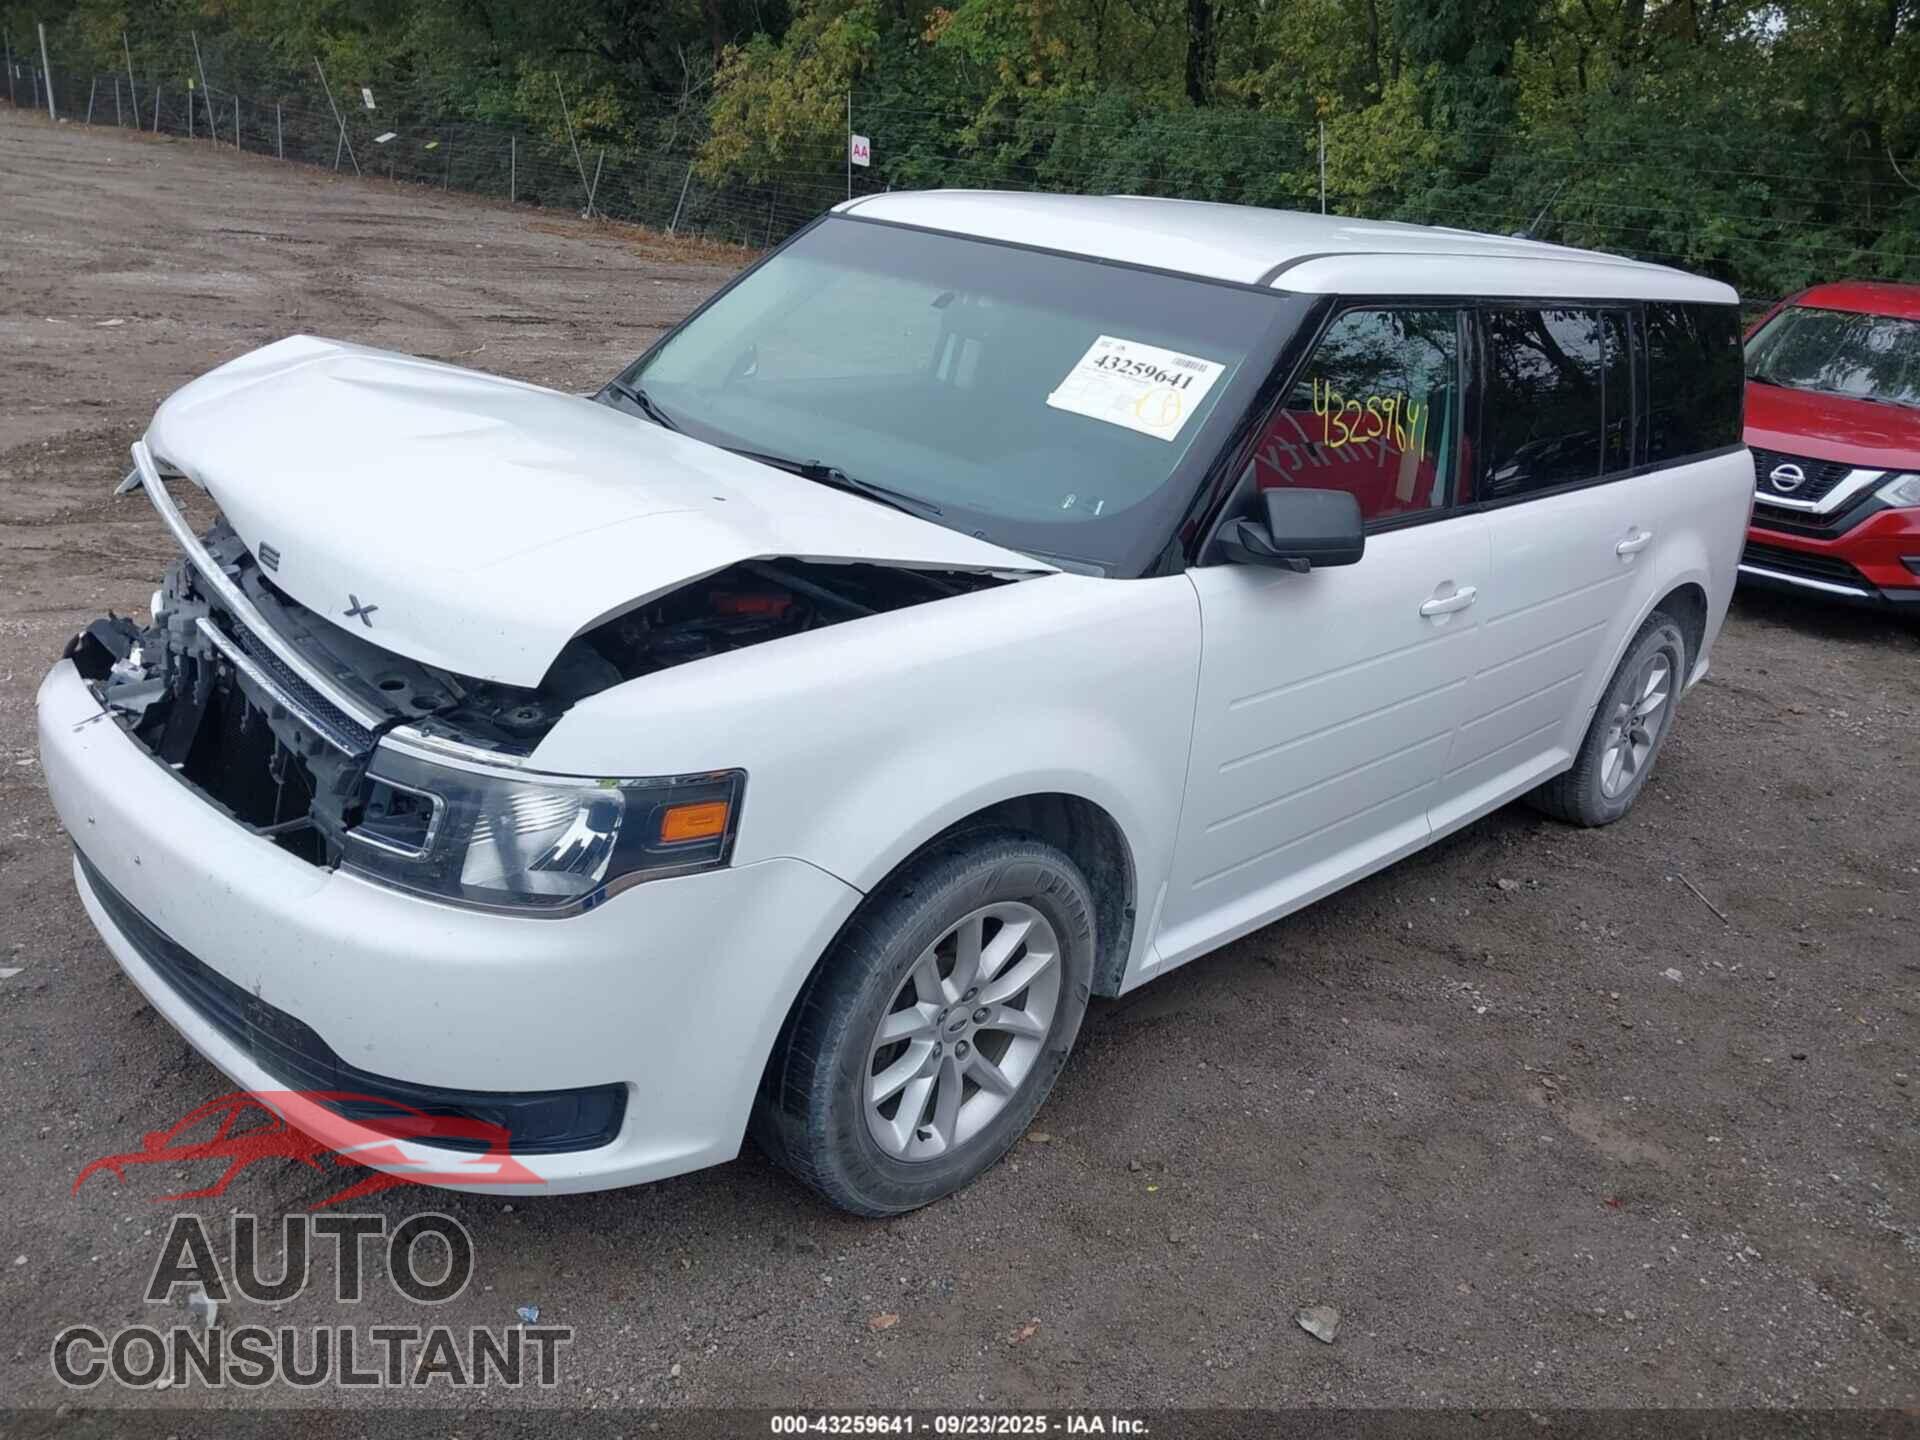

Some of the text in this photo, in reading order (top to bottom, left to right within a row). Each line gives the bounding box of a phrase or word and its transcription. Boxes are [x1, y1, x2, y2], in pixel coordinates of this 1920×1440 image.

[853, 143, 869, 159] AA
[1094, 354, 1195, 390] 43259641
[1312, 377, 1430, 463] 43259641
[343, 593, 379, 628] X
